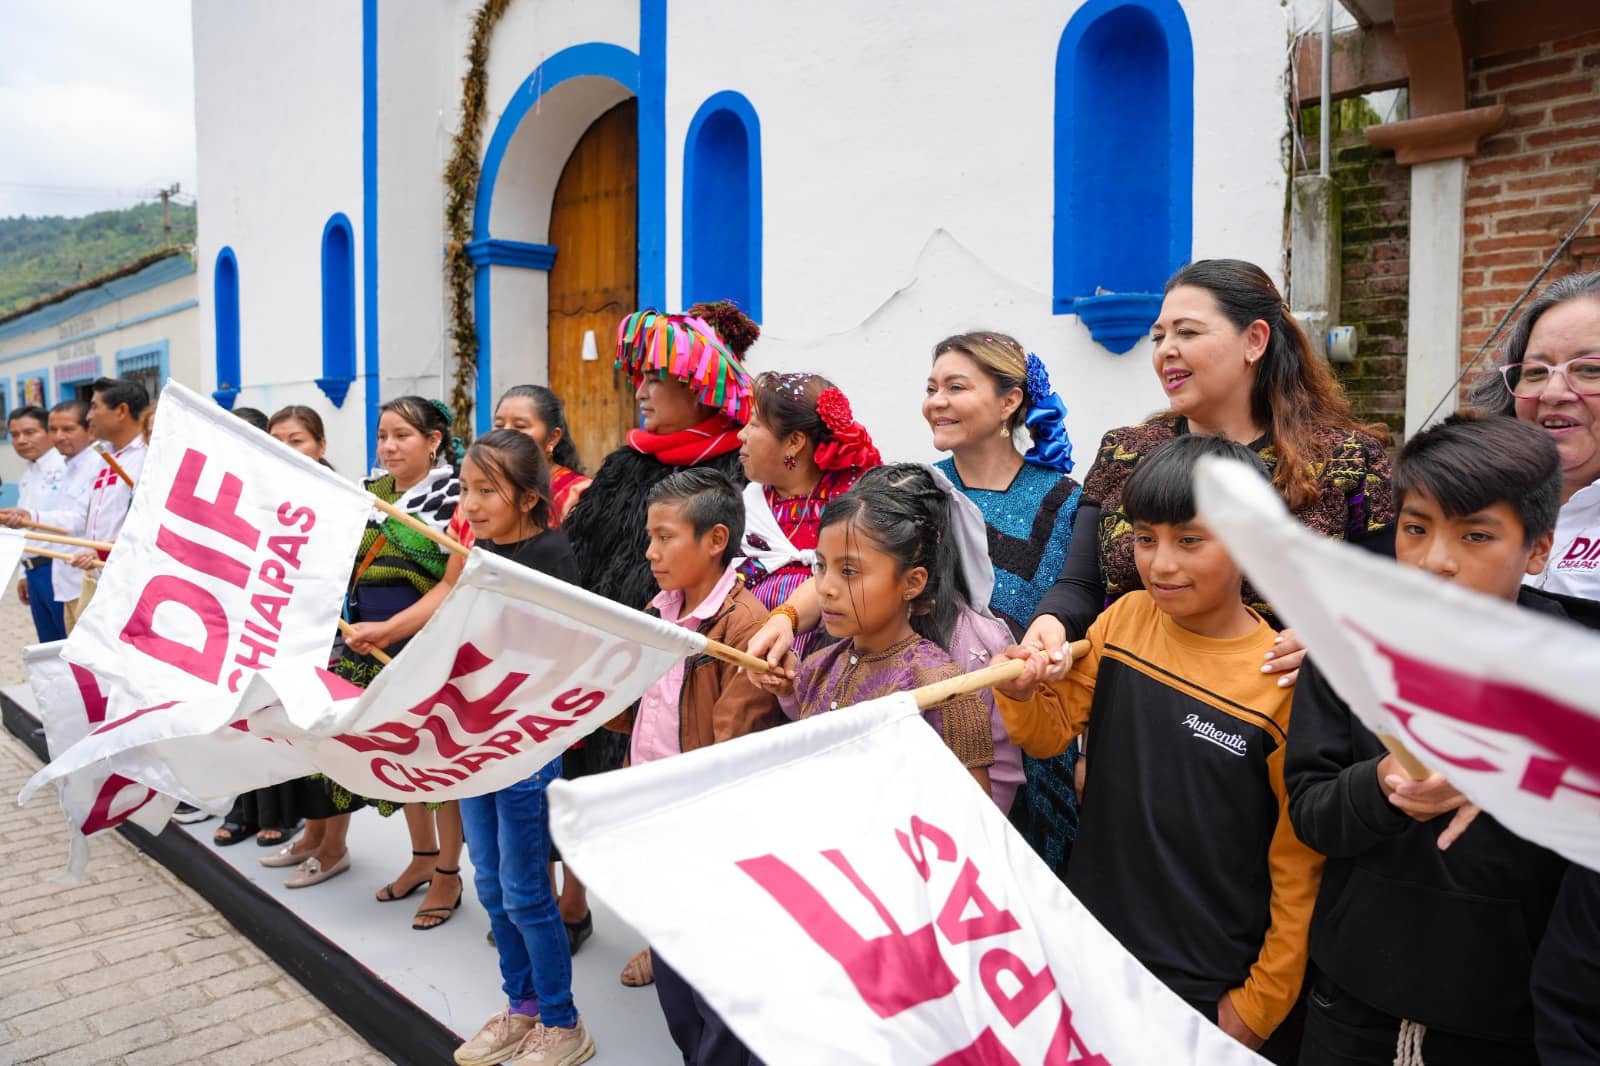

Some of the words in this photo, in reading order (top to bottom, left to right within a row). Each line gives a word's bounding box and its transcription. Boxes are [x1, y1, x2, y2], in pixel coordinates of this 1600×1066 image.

[119, 448, 262, 685] DIF
[370, 687, 605, 792] CHIAPAS
[1181, 713, 1247, 755] Authentic
